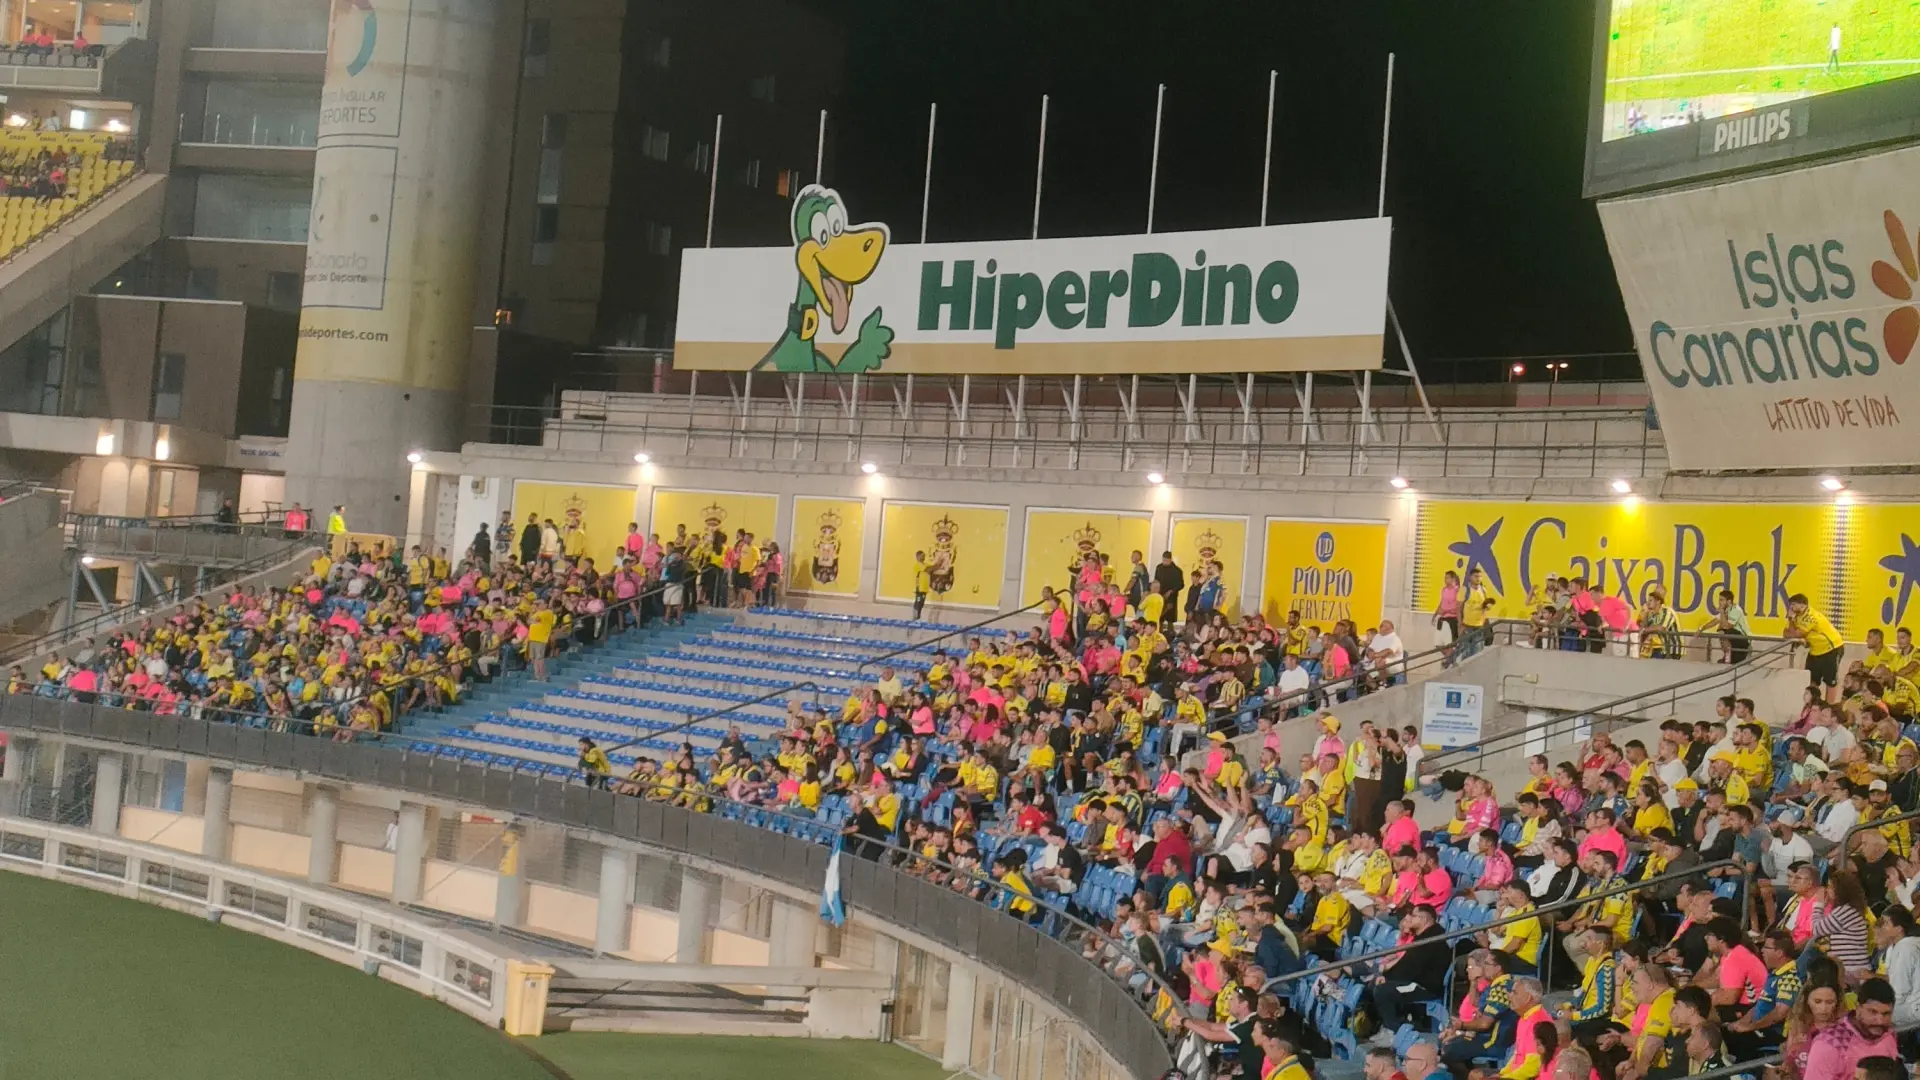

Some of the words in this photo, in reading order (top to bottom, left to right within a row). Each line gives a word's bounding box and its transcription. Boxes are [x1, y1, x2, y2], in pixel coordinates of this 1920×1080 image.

[1713, 108, 1791, 152] PHILIPS
[917, 250, 1299, 349] HiperDino
[1728, 233, 1856, 309] Islas
[1650, 307, 1880, 388] Canarias
[1763, 397, 1830, 432] LATITUD
[1832, 399, 1859, 428] DE
[1856, 394, 1900, 428] VIDA
[1292, 566, 1320, 596] PÍO
[1324, 567, 1353, 598] PÍO
[1520, 517, 1798, 618] CaixaBank
[1291, 598, 1351, 621] CERVEZAS
